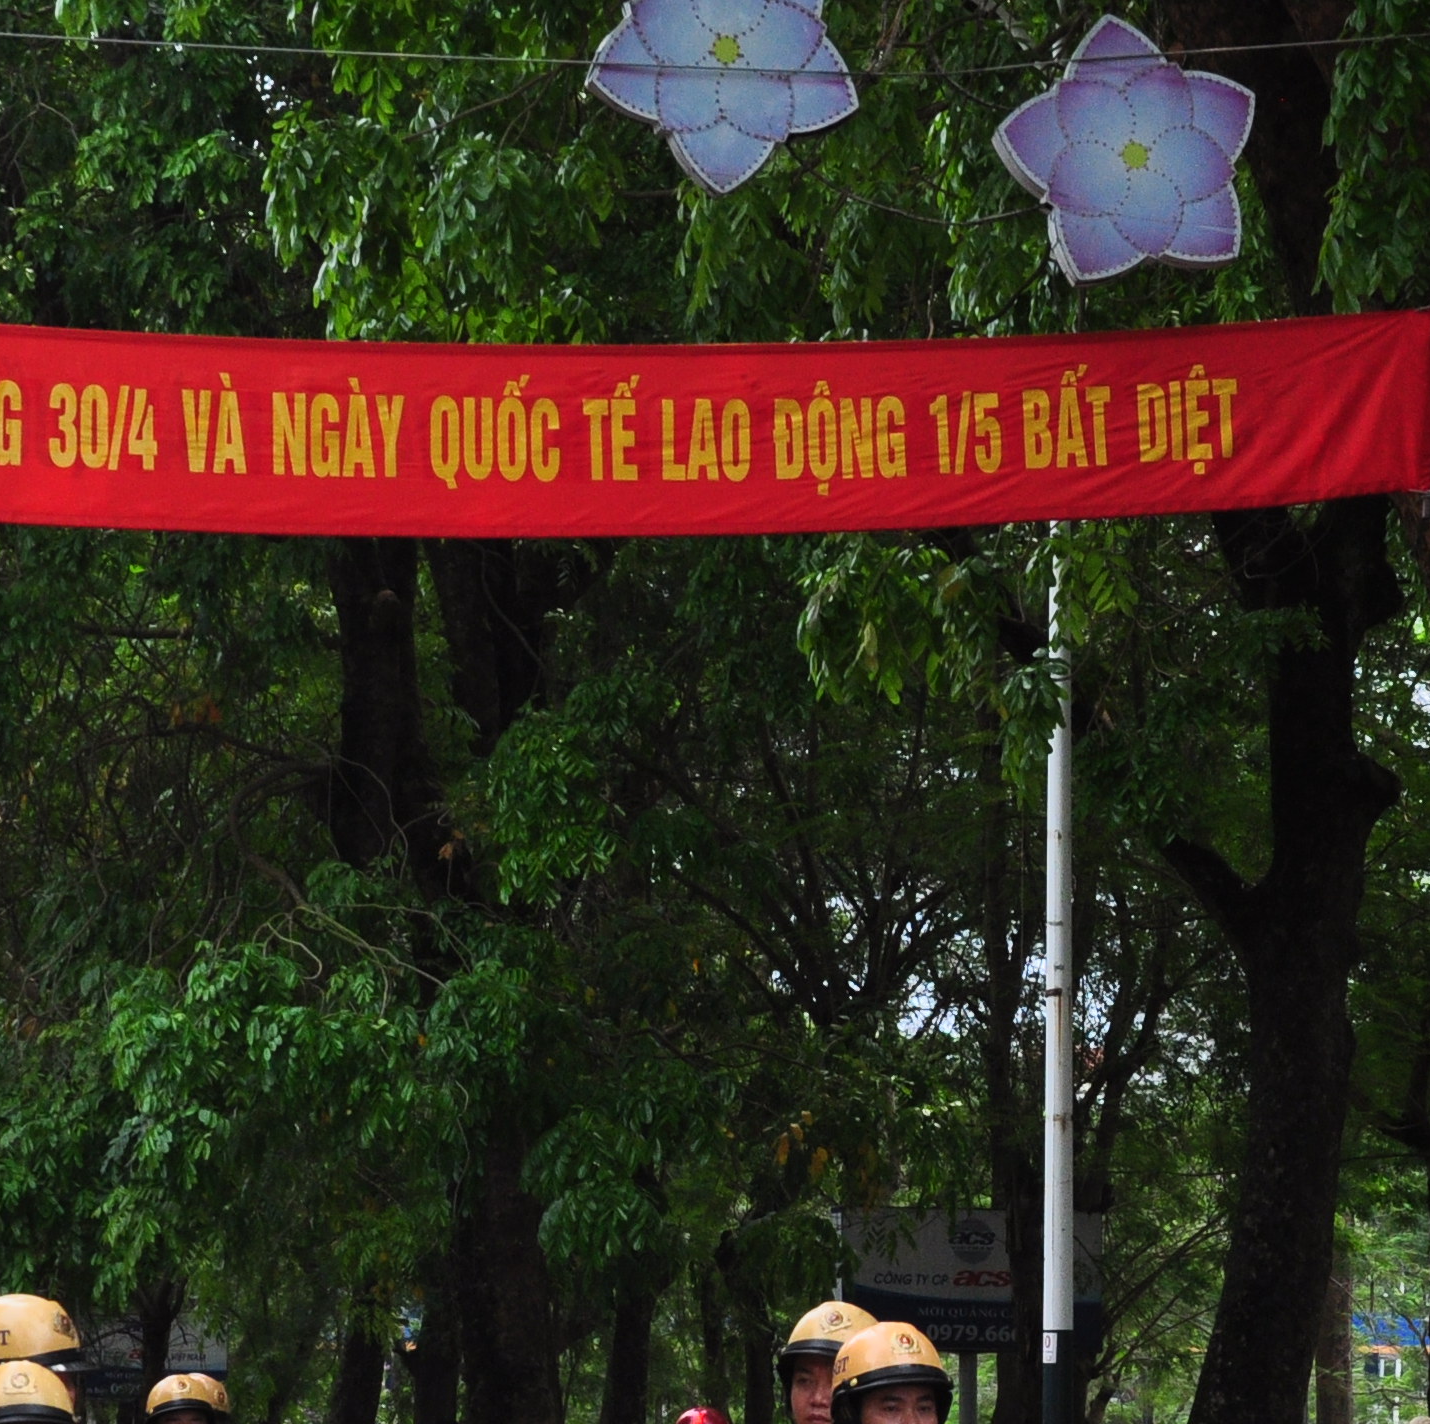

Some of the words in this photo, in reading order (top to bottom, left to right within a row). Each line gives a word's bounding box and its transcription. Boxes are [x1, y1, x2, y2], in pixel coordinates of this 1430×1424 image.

[49, 383, 158, 471] 30/4
[182, 372, 247, 474] VÀ
[272, 377, 405, 478] NGÀY
[430, 374, 561, 489] QUỐC
[582, 375, 638, 481] TẾ
[662, 398, 752, 482] LAO
[773, 381, 907, 496] ĐỘNG
[929, 391, 1002, 475] 1/5
[1022, 364, 1111, 469] BẤT
[1137, 364, 1238, 476] DIỆT
[874, 1270, 912, 1285] CÔNG
[916, 1273, 929, 1286] TY
